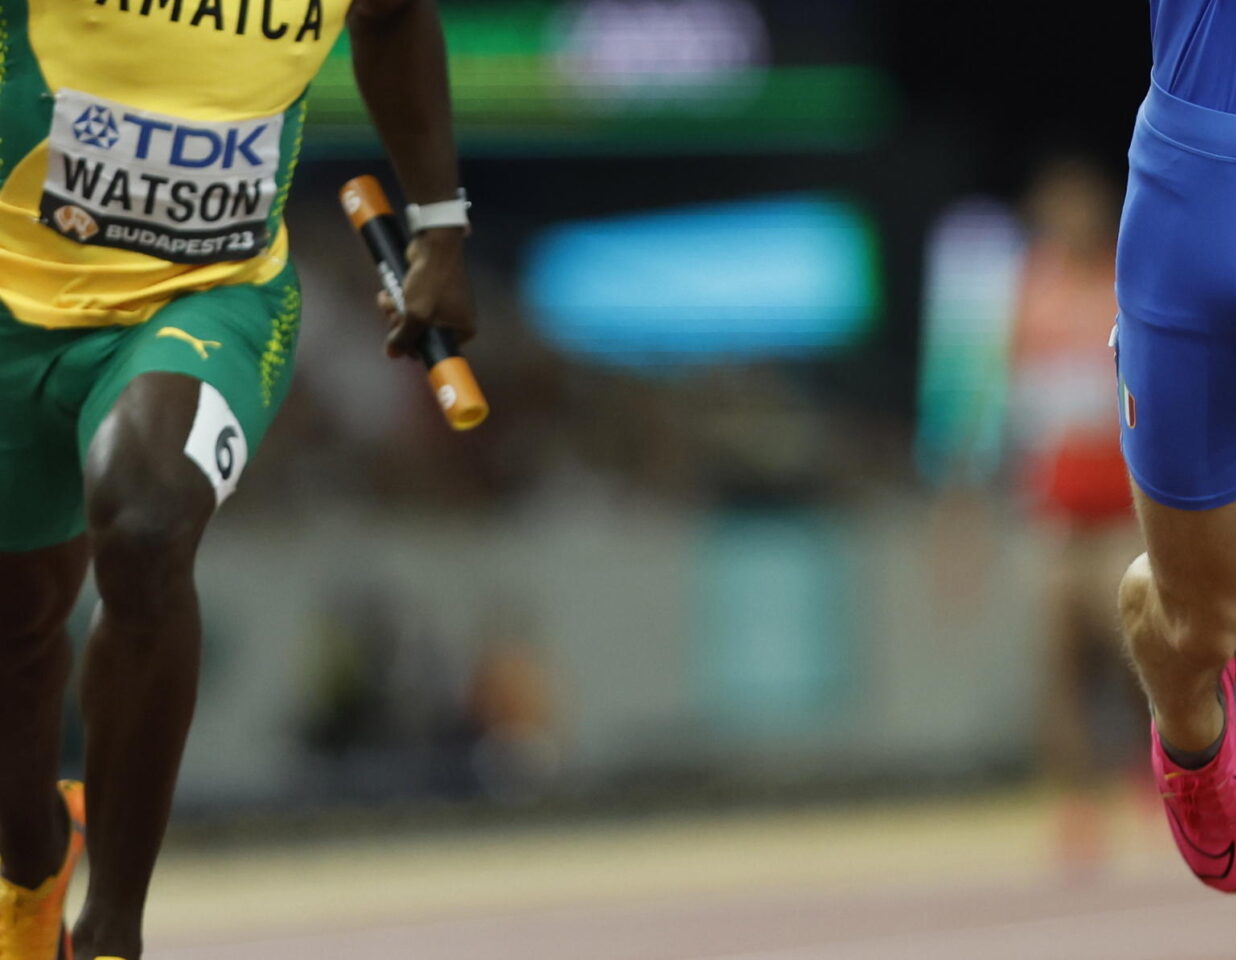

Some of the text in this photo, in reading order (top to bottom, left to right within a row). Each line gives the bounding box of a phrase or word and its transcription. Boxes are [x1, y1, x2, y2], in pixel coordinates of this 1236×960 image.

[122, 112, 269, 169] TDK
[62, 152, 263, 223] WATSON
[105, 224, 255, 255] BUDAPEST 23
[214, 425, 238, 481] 6
